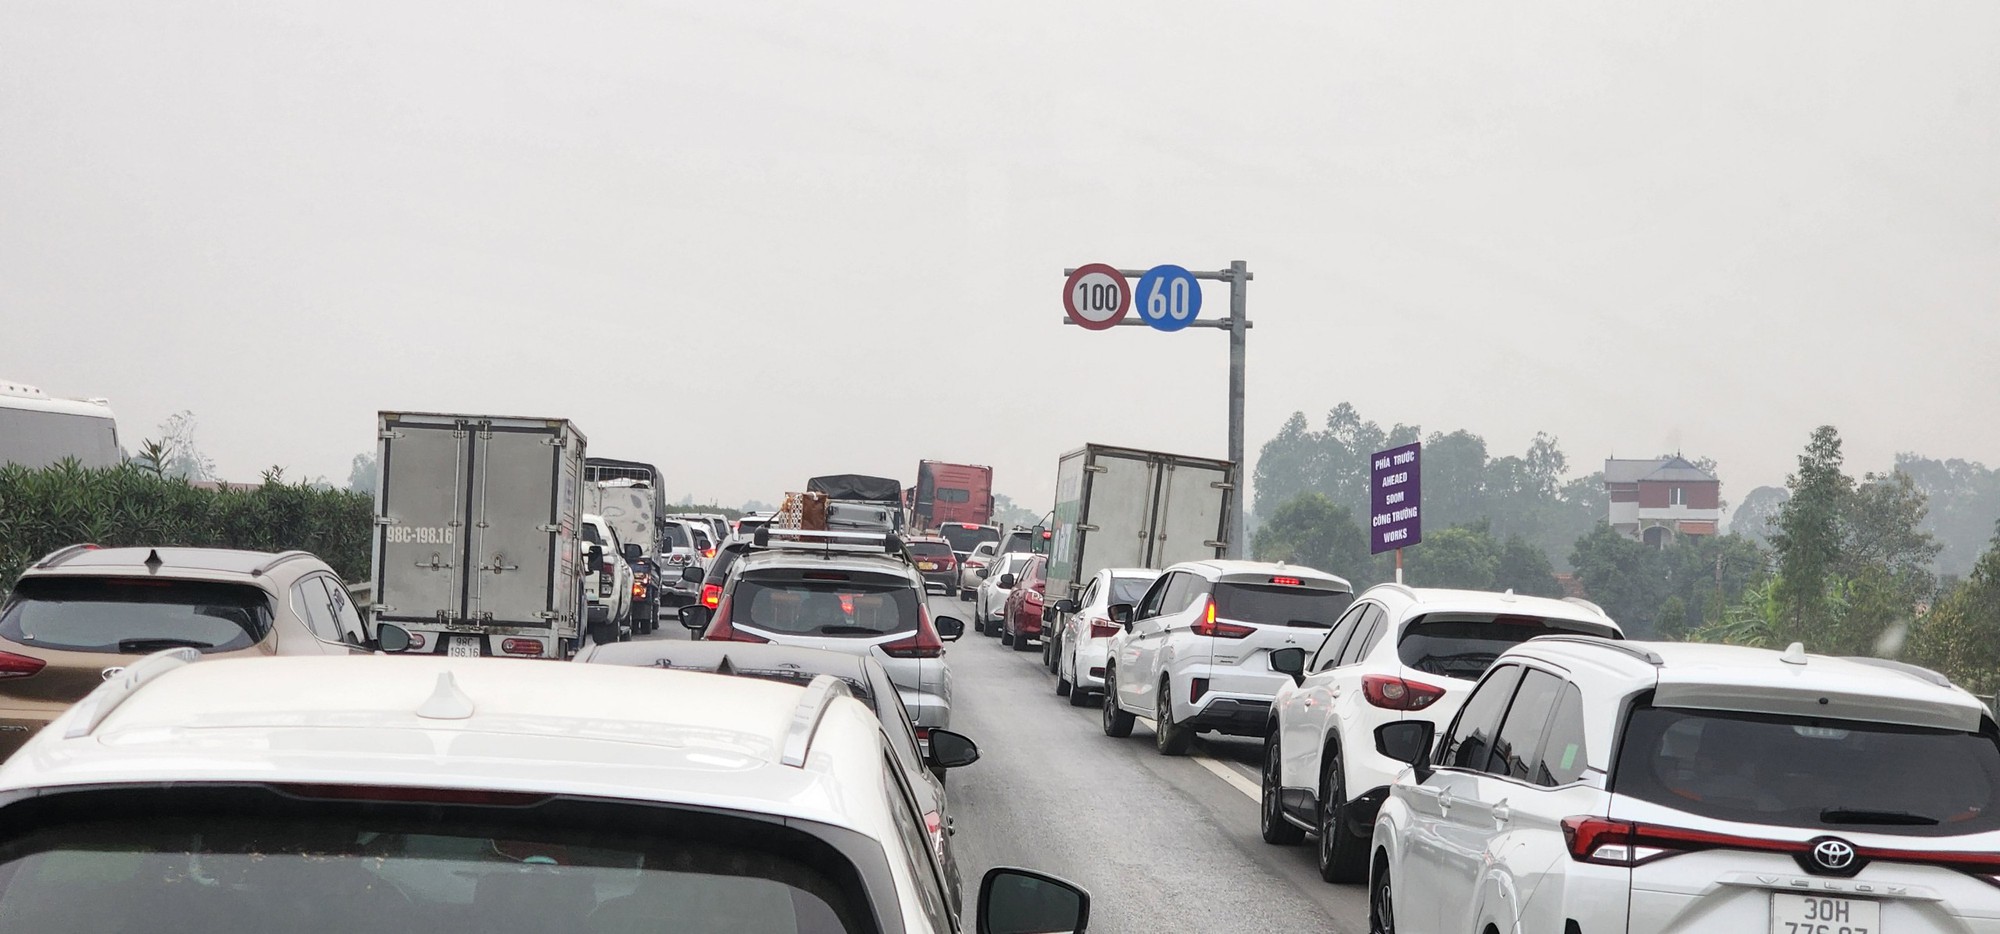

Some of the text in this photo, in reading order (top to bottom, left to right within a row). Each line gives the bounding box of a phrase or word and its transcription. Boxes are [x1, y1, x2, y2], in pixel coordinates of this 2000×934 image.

[1079, 283, 1118, 312] 100
[1147, 277, 1190, 320] 60
[1375, 450, 1415, 471] PHÍA TRƯỚC
[1382, 471, 1408, 488] AHEAED
[1386, 491, 1405, 505] 500M
[1372, 506, 1418, 527] CÔNG TRƯỜNG
[386, 526, 453, 544] 98C-198.16
[1383, 527, 1408, 543] WORKS
[456, 637, 473, 647] 98C
[450, 647, 479, 657] 198.16
[1756, 875, 1907, 895] VELOZ
[1804, 898, 1849, 923] 30H
